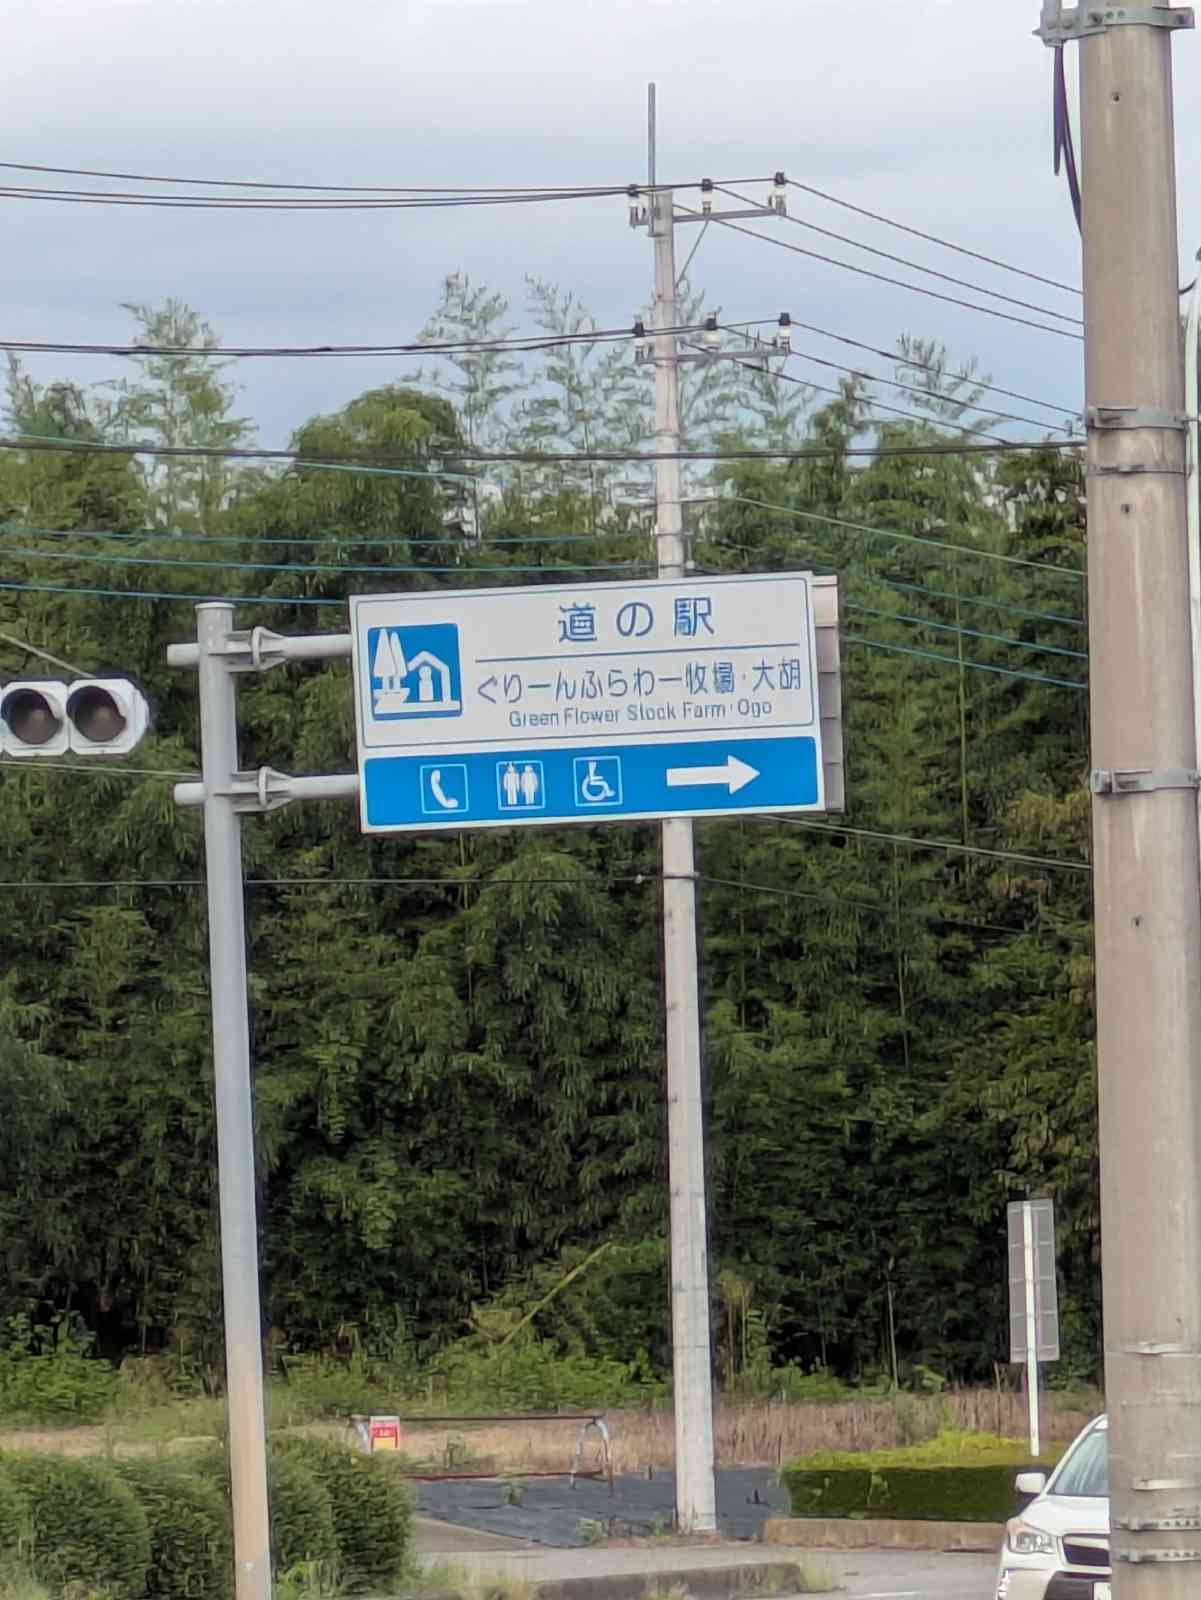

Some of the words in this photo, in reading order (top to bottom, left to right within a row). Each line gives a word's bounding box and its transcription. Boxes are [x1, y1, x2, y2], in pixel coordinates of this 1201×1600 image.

[557, 597, 715, 643] 道の駅
[509, 709, 560, 728] Green
[564, 707, 619, 726] Flower
[627, 701, 677, 721] Stock
